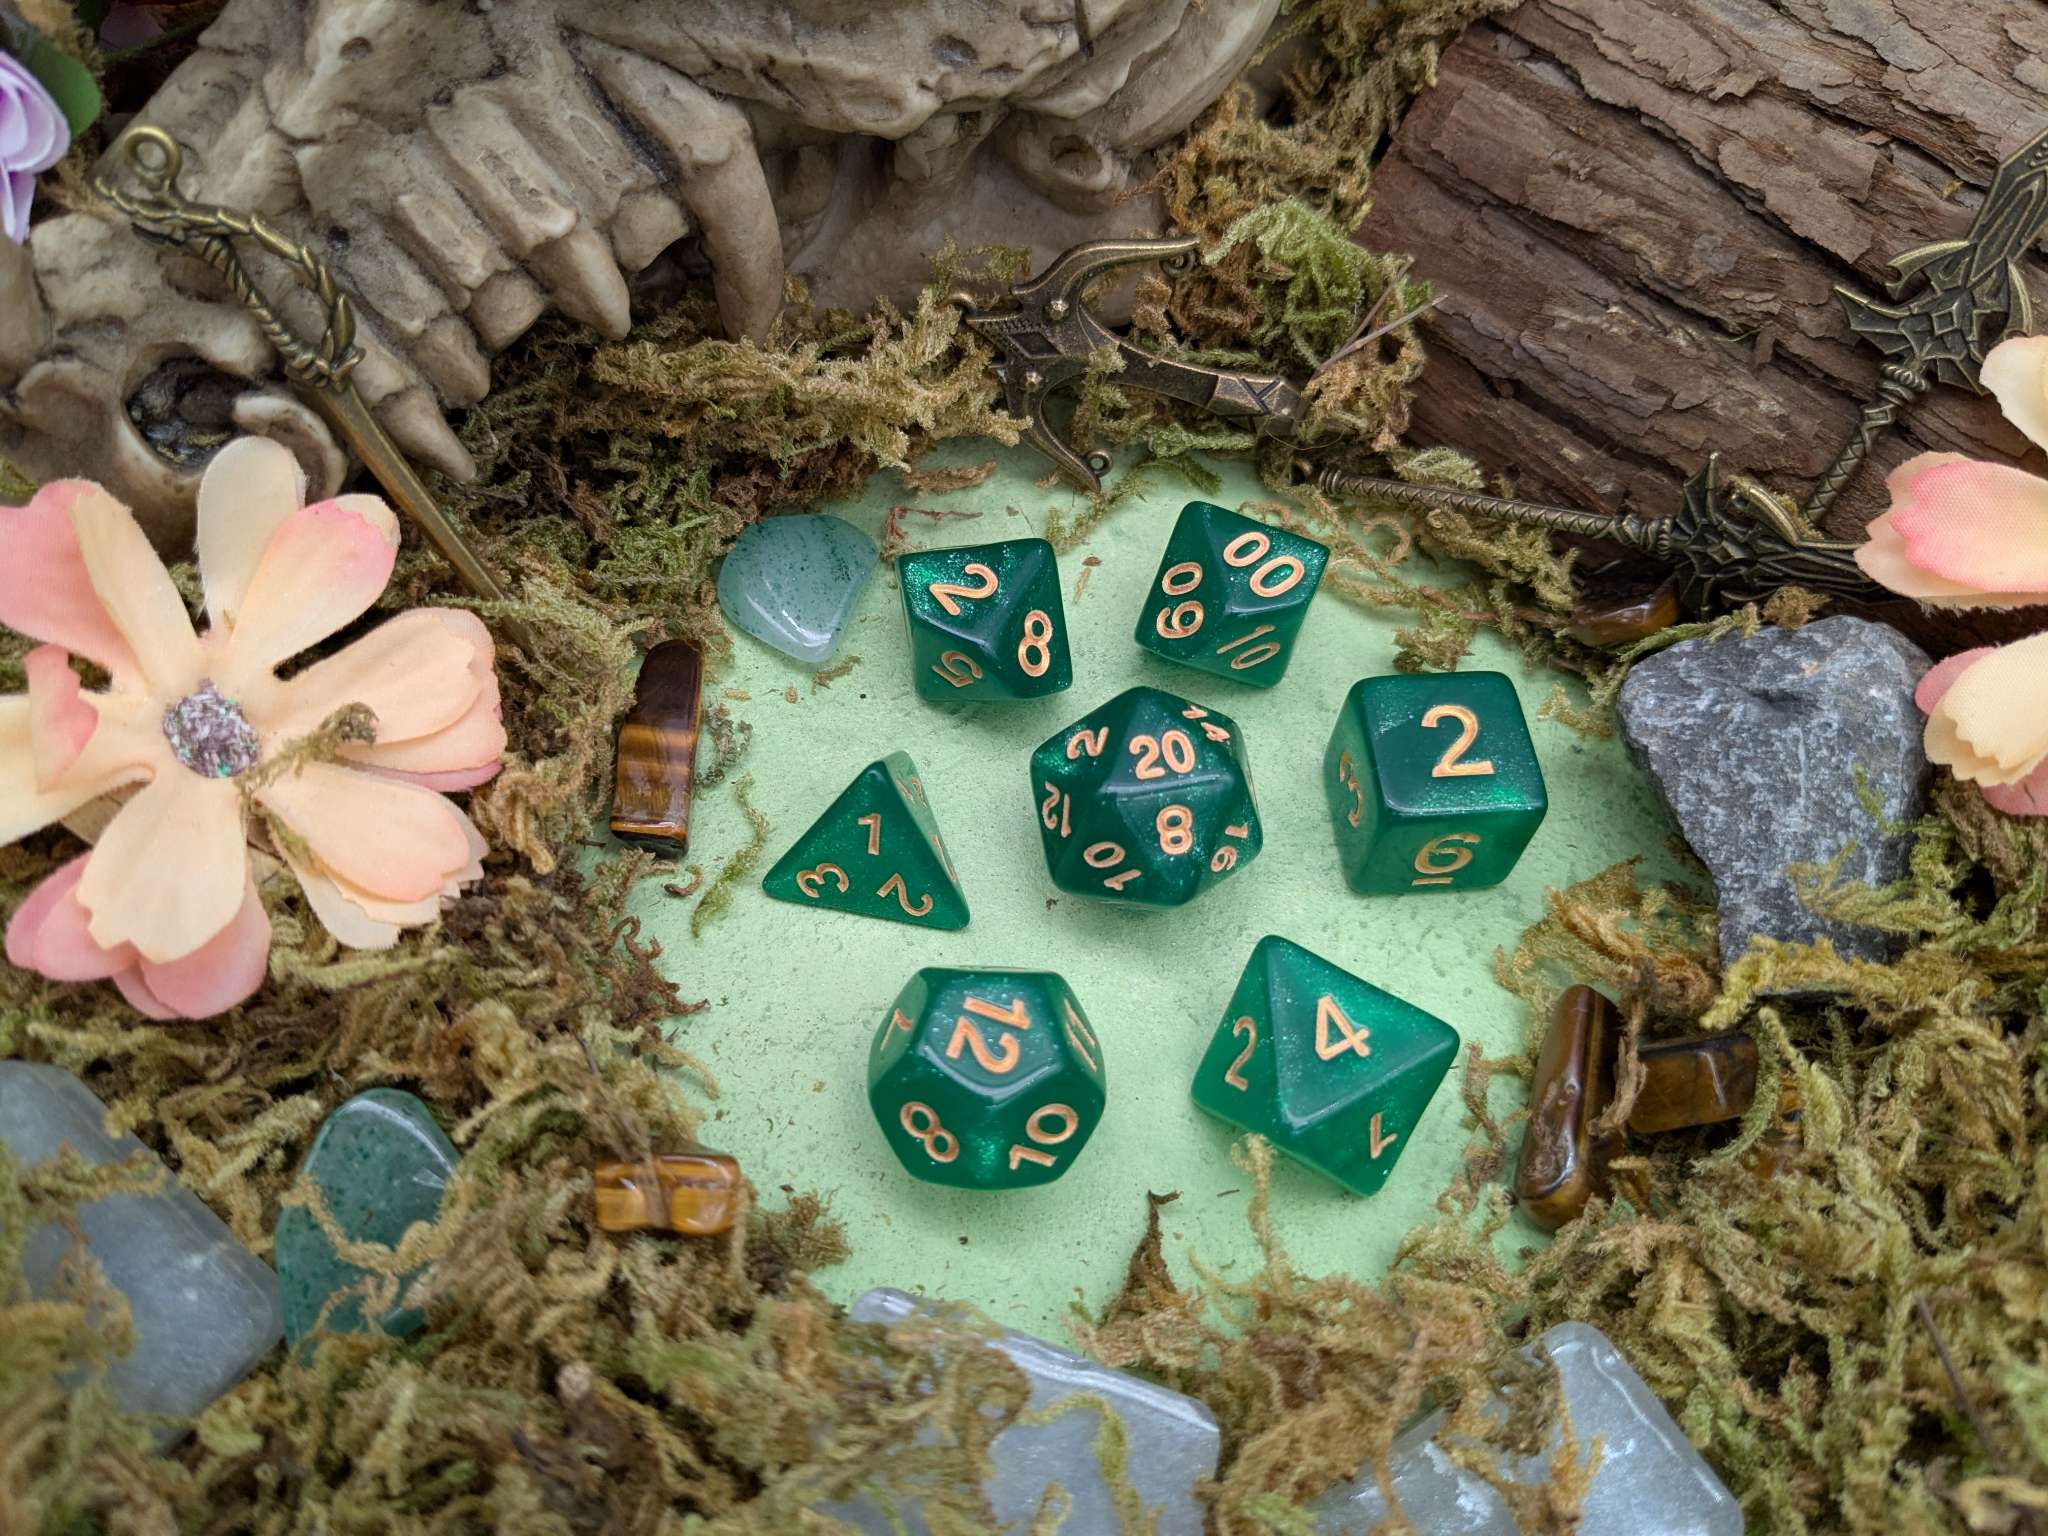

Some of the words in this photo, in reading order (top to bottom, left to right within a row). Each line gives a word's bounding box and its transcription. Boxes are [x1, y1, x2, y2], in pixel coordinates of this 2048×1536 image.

[928, 562, 999, 616] 2
[1222, 530, 1306, 598] 00
[931, 650, 983, 688] 5
[1018, 609, 1053, 677] 8
[1215, 624, 1281, 670] 10
[1066, 725, 1111, 760] 2
[1129, 730, 1196, 781] 20
[1420, 704, 1496, 778] 2
[1338, 751, 1364, 828] 3
[857, 812, 882, 856] 1
[1156, 805, 1193, 855] 8
[797, 863, 849, 897] 3
[1084, 843, 1140, 889] 10
[1411, 832, 1481, 886] 6
[876, 872, 934, 918] 2
[945, 995, 1031, 1075] 12
[1223, 1015, 1259, 1091] 2
[1314, 993, 1372, 1062] 4
[901, 1102, 958, 1162] 8
[1008, 1102, 1079, 1171] 10
[1369, 1112, 1398, 1160] 1
